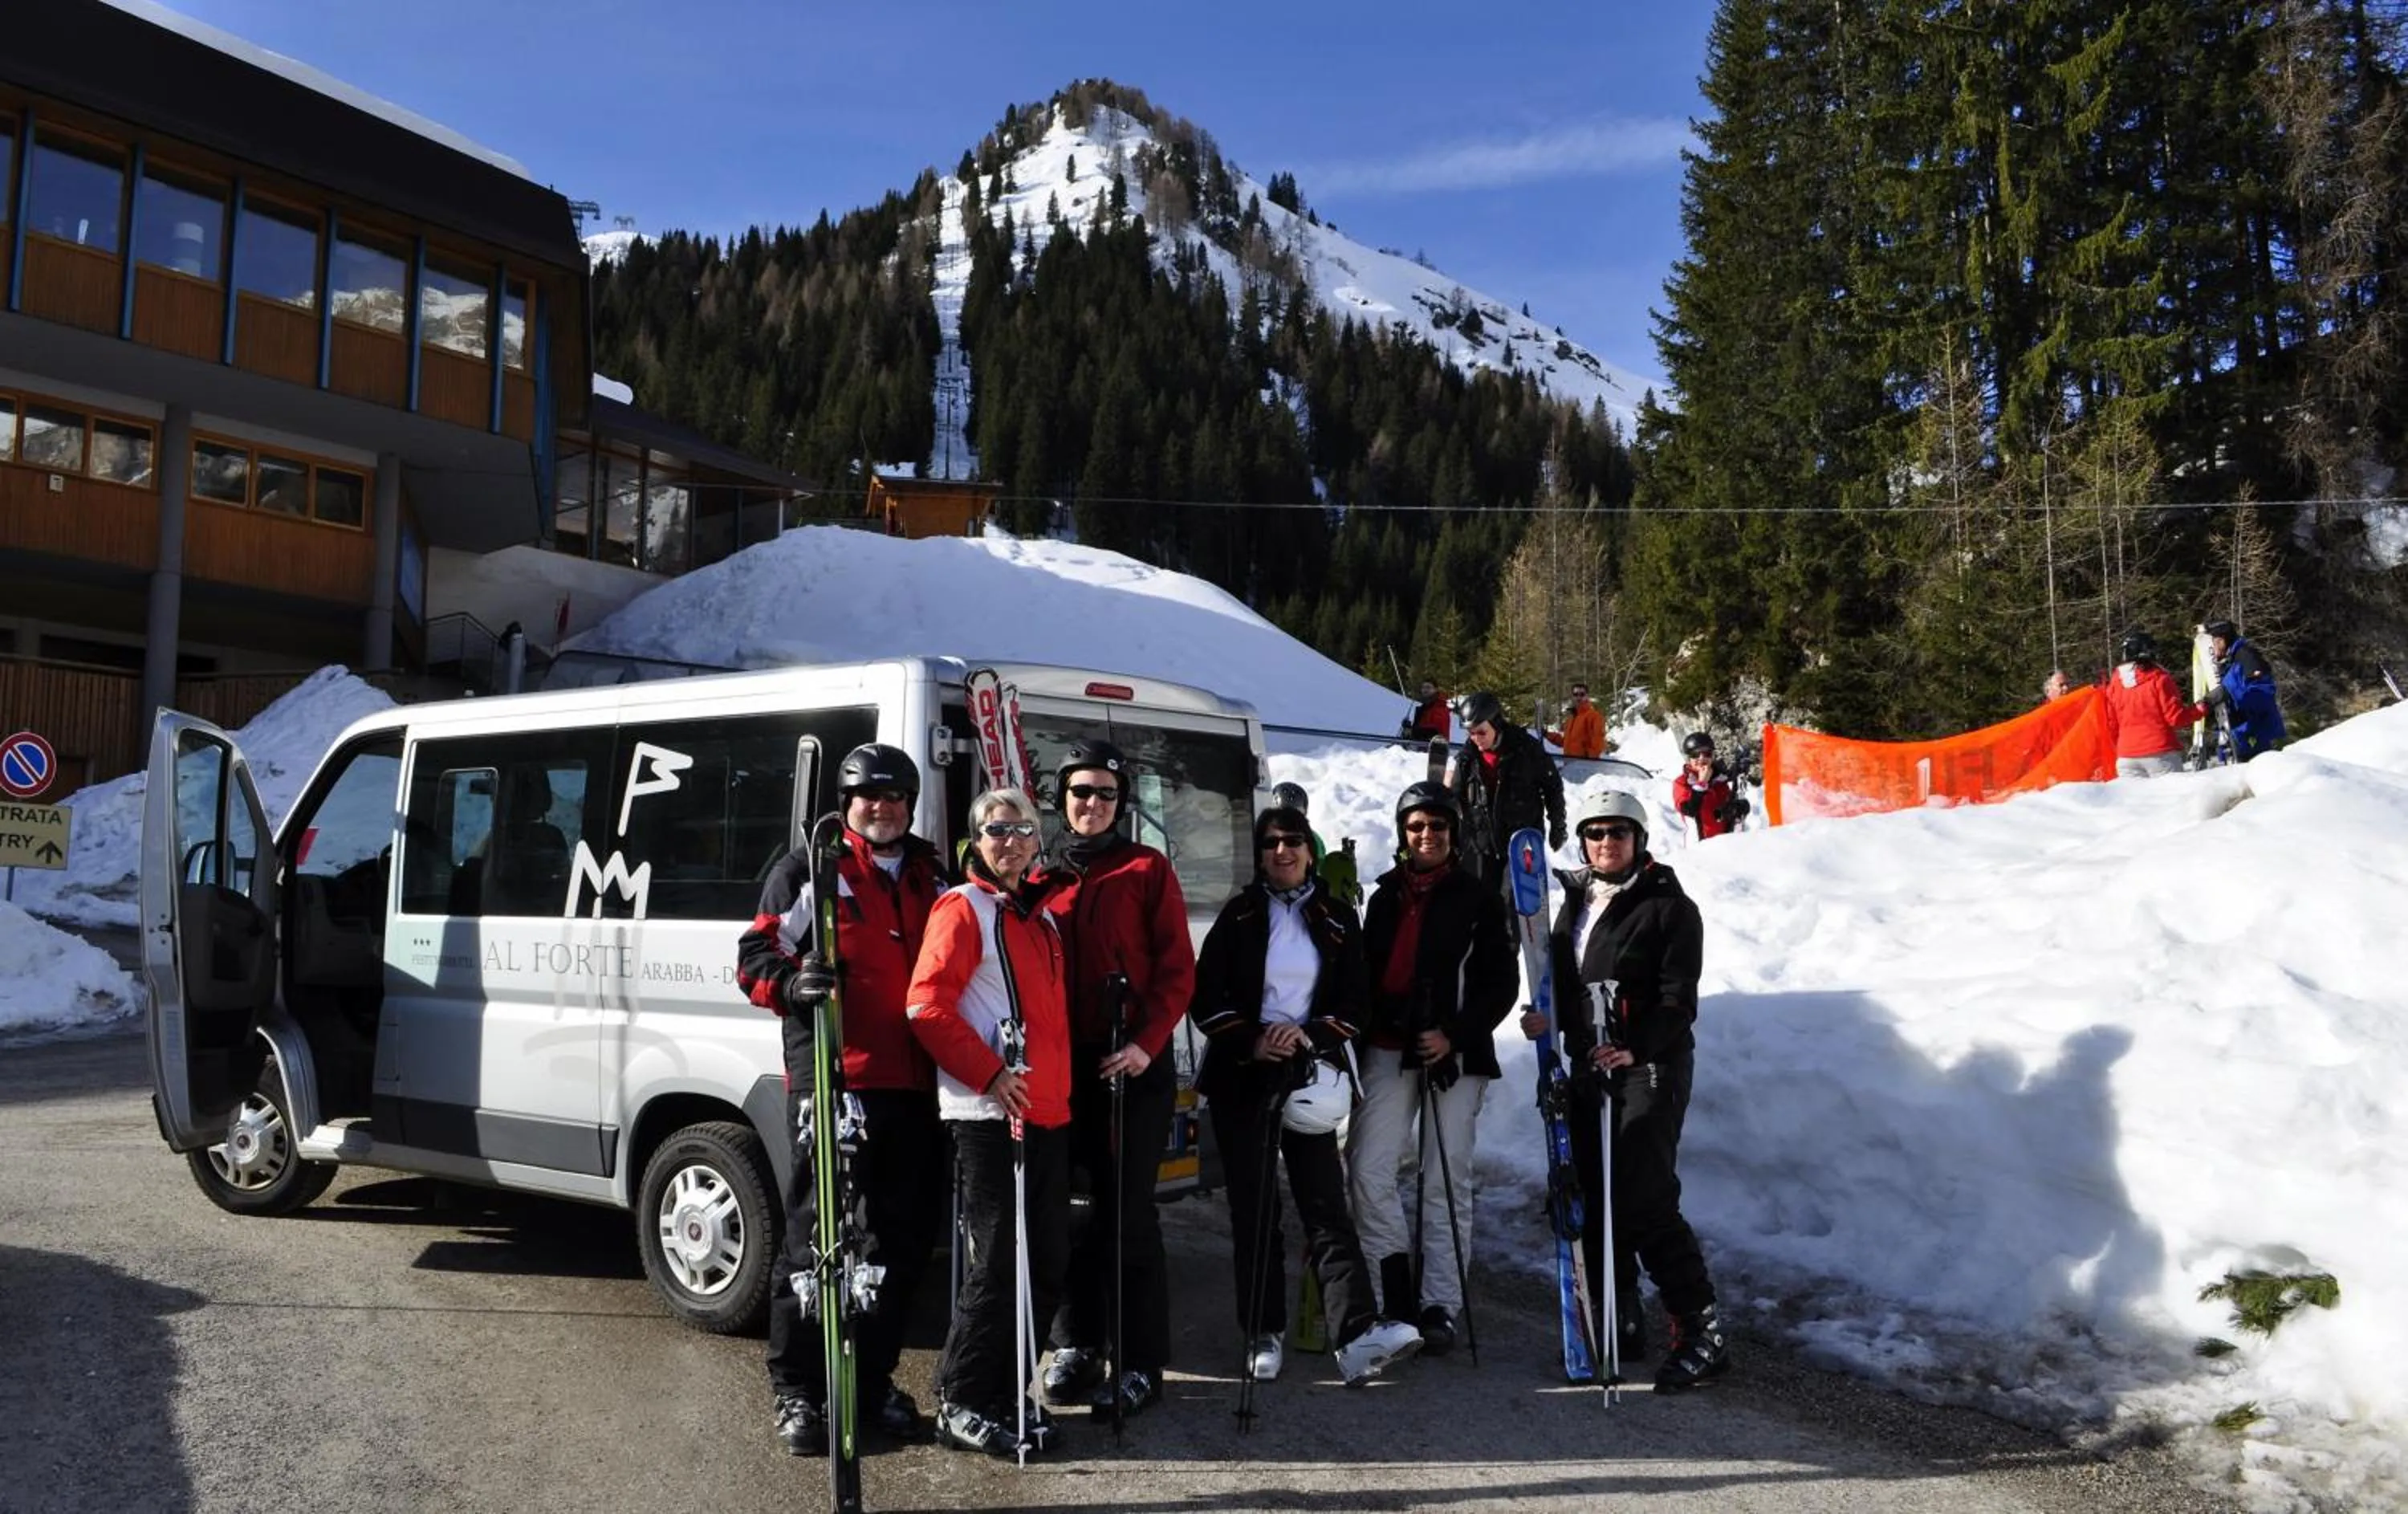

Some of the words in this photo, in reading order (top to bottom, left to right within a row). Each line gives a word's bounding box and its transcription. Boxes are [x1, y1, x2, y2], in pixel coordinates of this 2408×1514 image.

[978, 689, 1005, 791] HEAD
[483, 941, 520, 972] AL
[532, 942, 633, 979] FORTE
[641, 963, 704, 983] ARABBA
